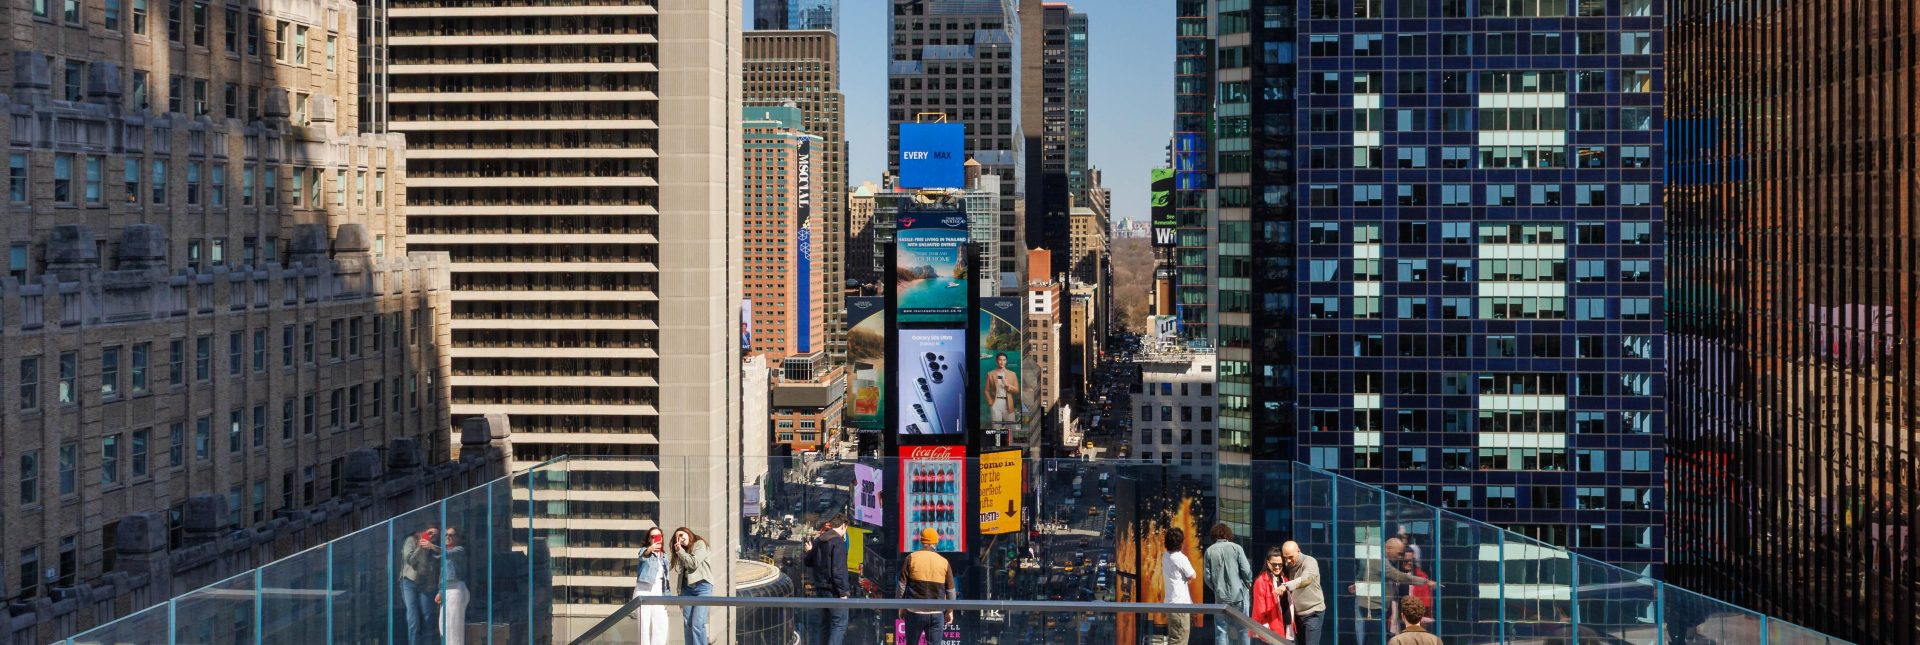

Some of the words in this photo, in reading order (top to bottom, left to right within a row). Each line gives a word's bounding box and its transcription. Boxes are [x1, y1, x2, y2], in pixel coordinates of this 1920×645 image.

[904, 151, 929, 160] EVERY
[934, 151, 952, 160] MAX
[989, 471, 1000, 482] the
